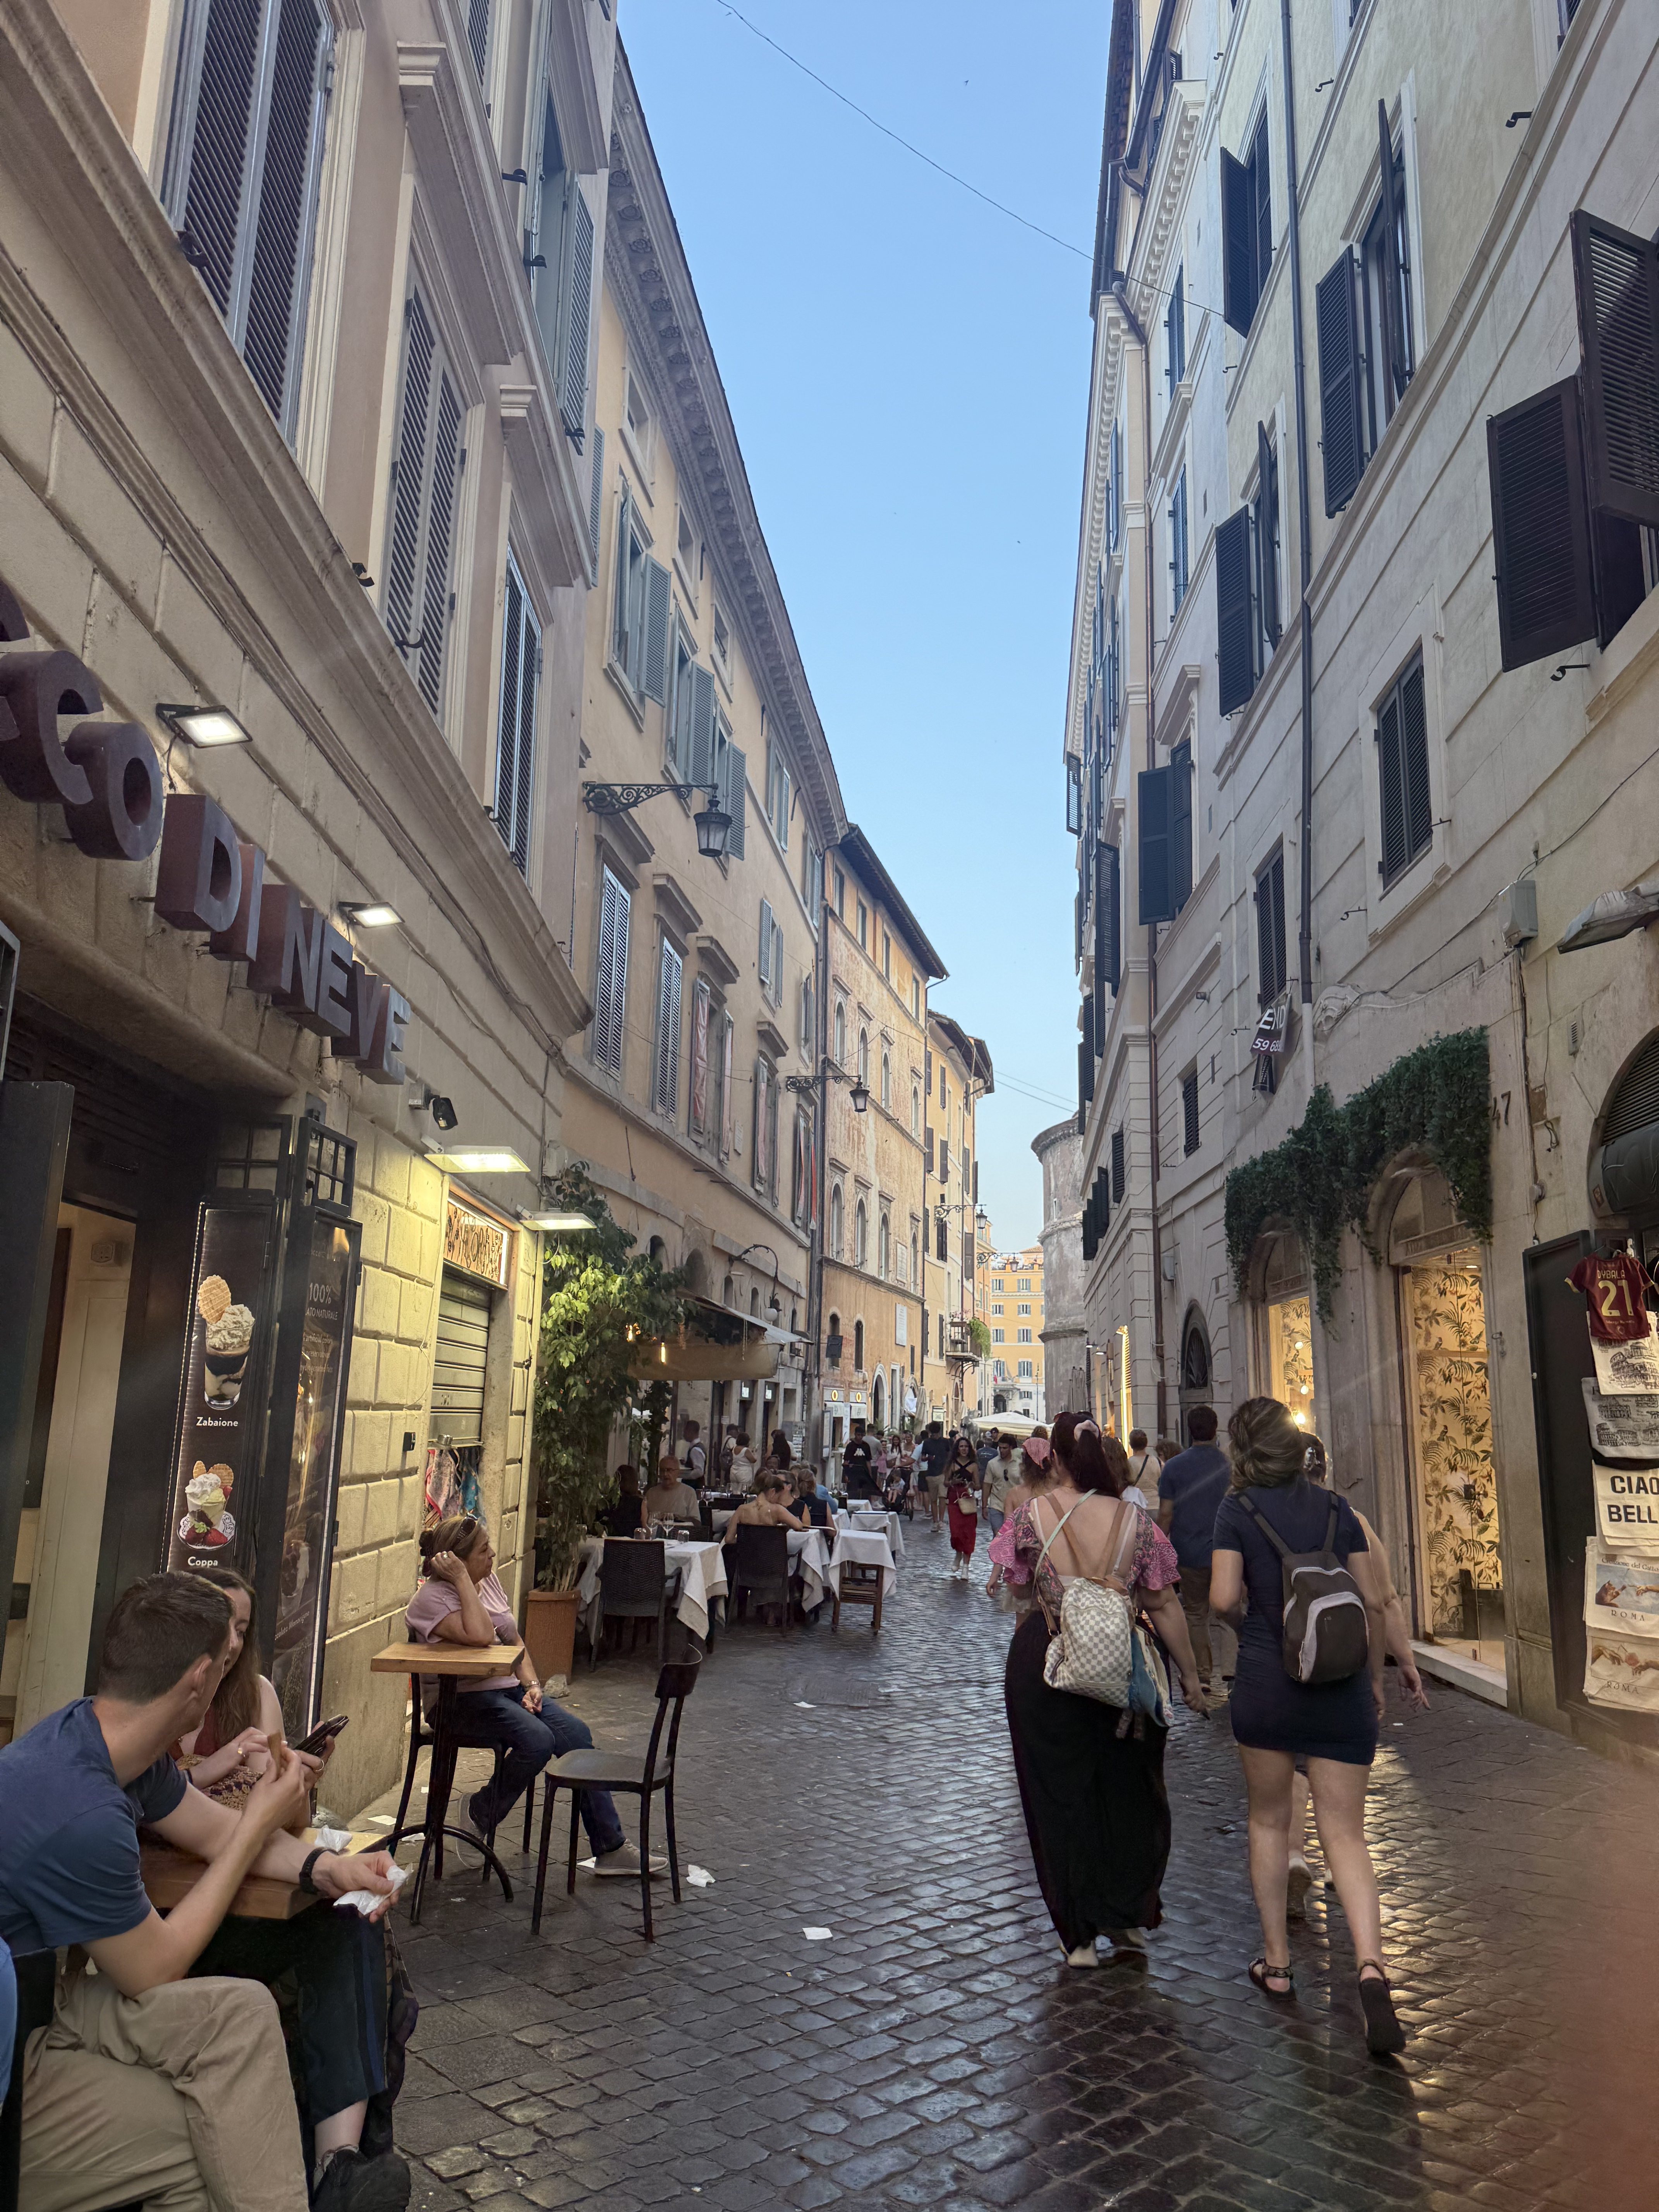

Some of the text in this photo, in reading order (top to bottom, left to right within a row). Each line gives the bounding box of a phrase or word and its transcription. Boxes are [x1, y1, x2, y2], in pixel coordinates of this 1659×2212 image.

[155, 794, 265, 962] DI
[247, 884, 410, 1085] NEVE
[1252, 1038, 1270, 1051] 59
[1492, 1090, 1511, 1130] 47
[1597, 1270, 1625, 1279] DYBALA
[309, 1282, 332, 1304] 100%
[1598, 1279, 1634, 1316] 21
[316, 1308, 338, 1321] NATURALE
[196, 1417, 239, 1427] Zabaione
[1607, 1504, 1658, 1524] BELL
[187, 1556, 218, 1568] Coppa
[1611, 1609, 1645, 1622] ROMA
[1607, 1681, 1639, 1695] ROMA
